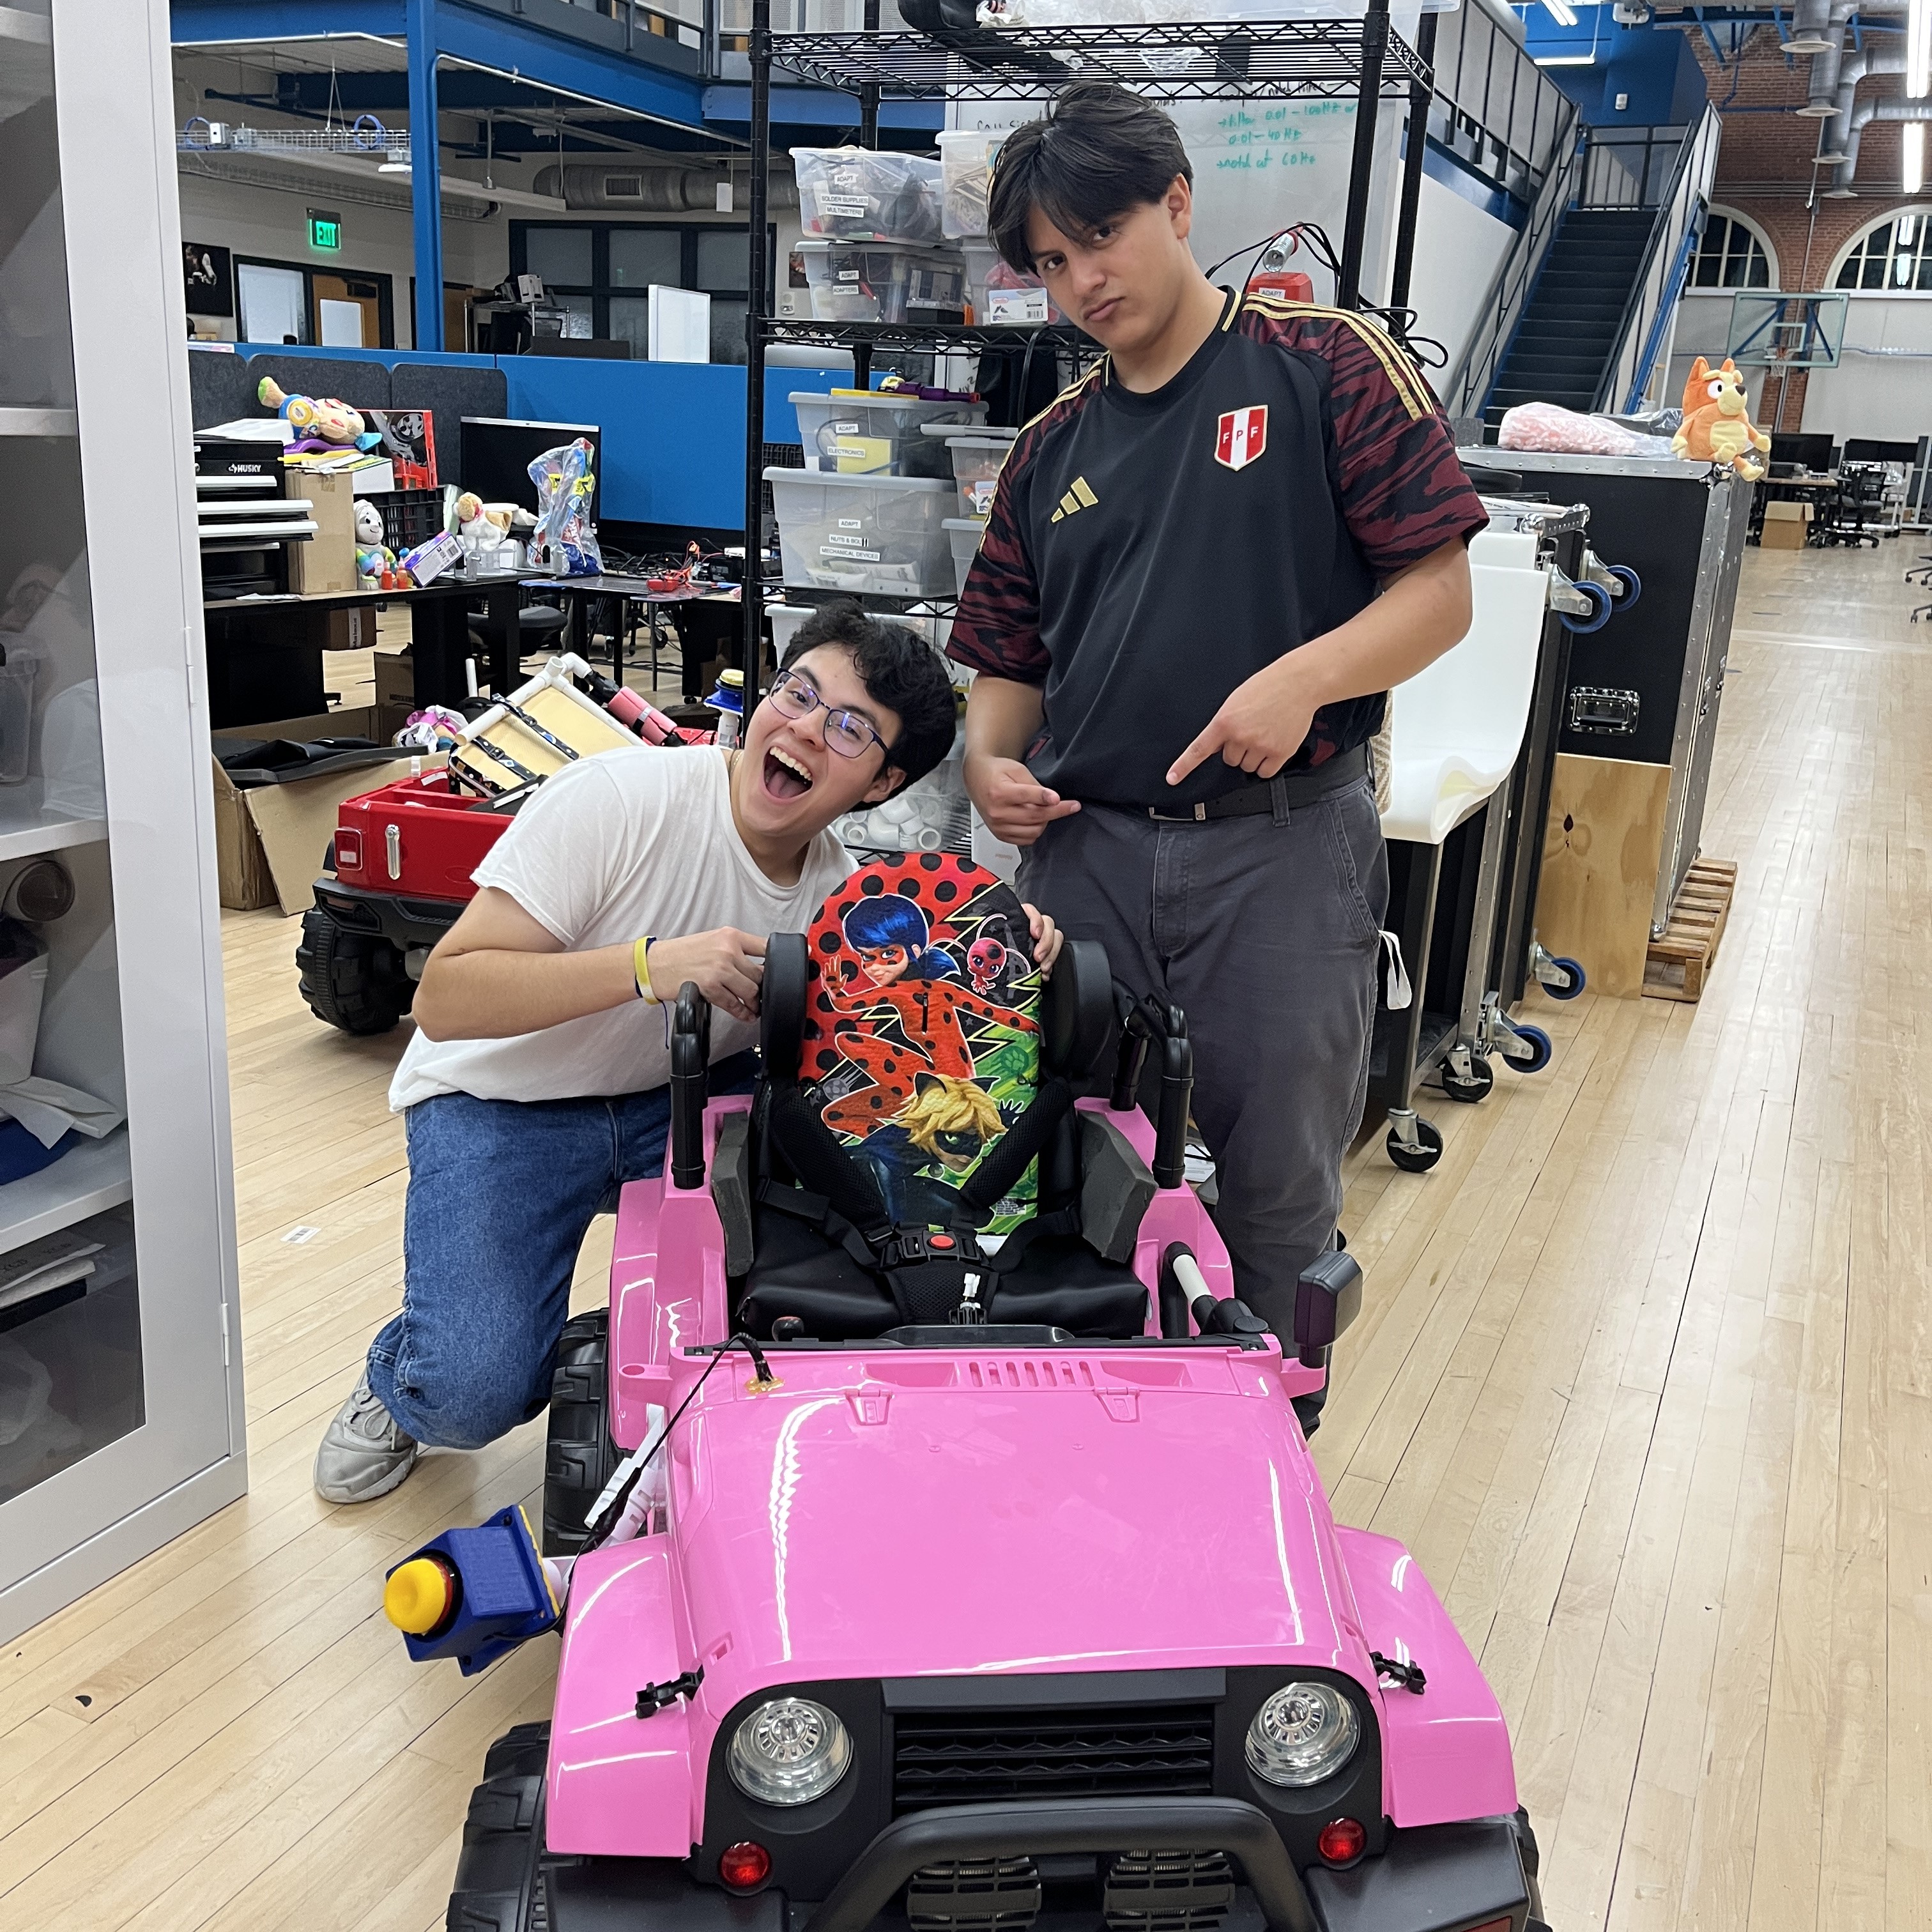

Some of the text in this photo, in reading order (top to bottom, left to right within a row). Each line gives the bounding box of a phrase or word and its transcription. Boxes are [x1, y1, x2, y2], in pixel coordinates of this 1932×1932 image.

[828, 448, 864, 456] ELECTRONICS
[237, 464, 261, 473] HUSKY
[822, 548, 879, 560] MECHANICAL DEVICES
